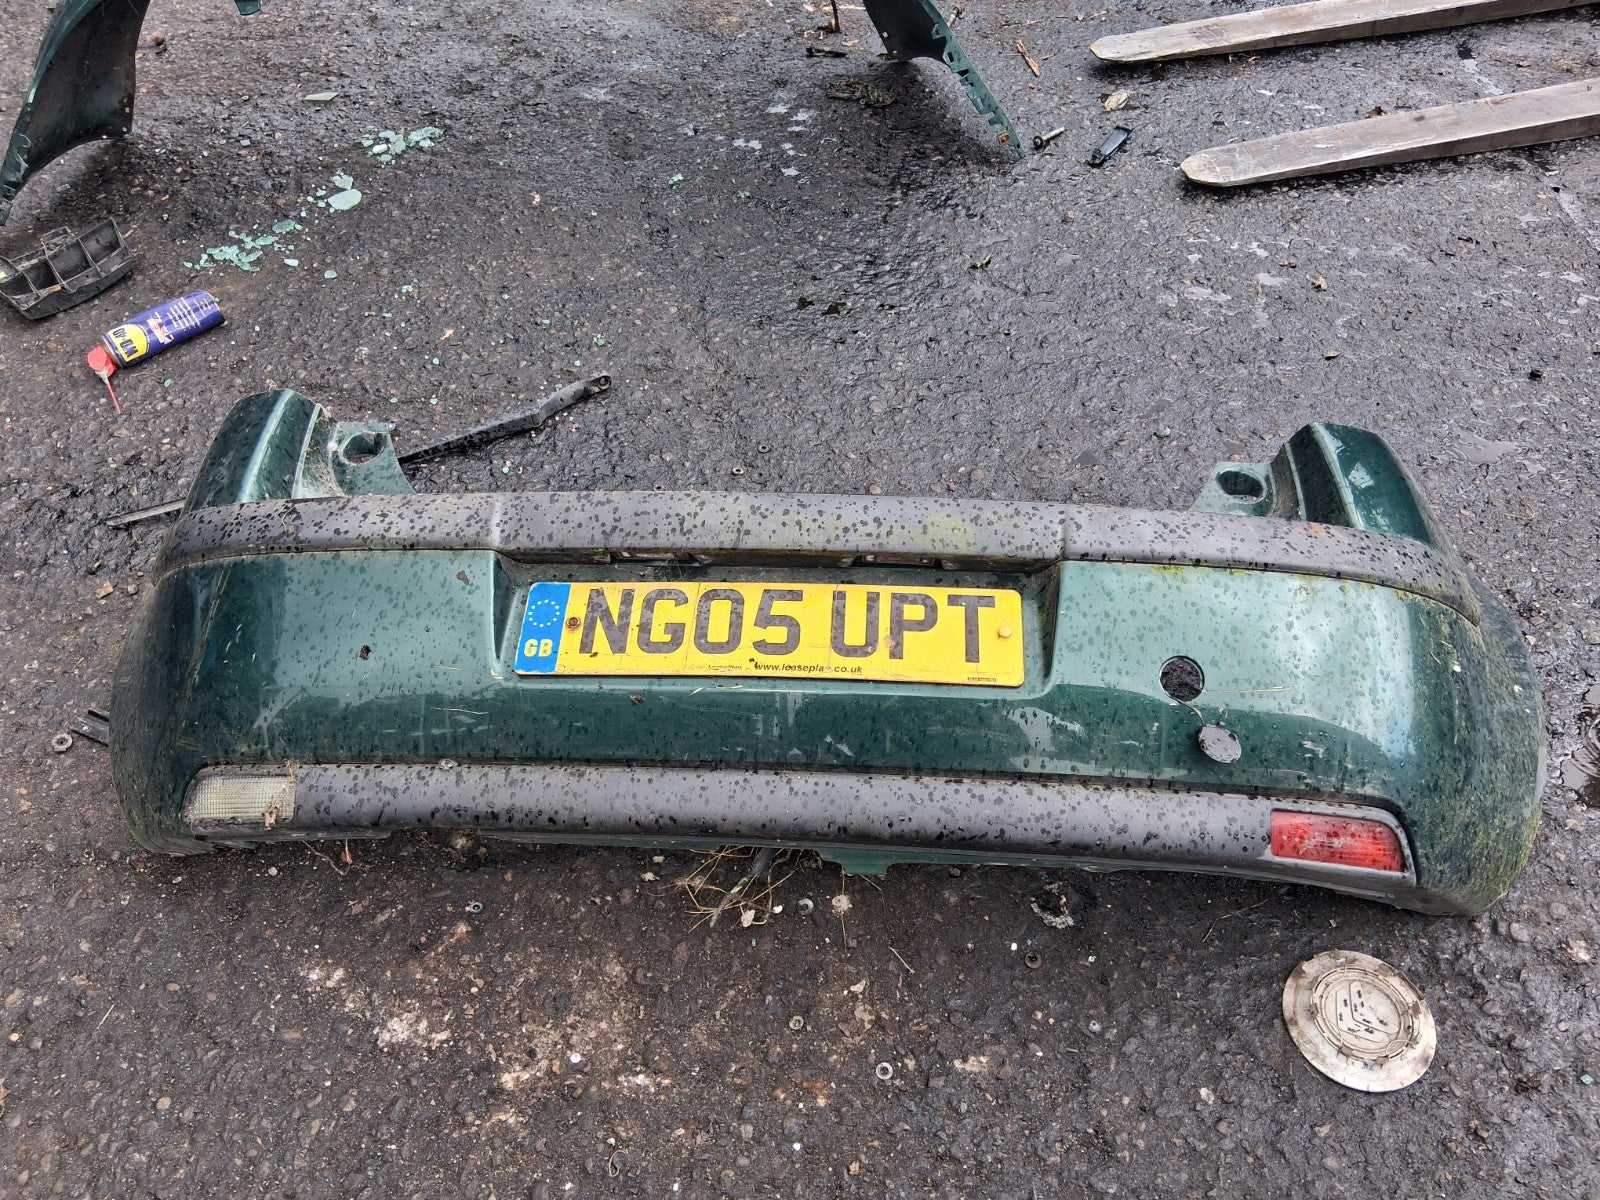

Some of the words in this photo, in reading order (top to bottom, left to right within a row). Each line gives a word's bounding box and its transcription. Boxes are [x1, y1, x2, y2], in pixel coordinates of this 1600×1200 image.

[112, 327, 139, 358] WD-40
[578, 588, 802, 656] NG05
[830, 590, 996, 663] UPT
[523, 638, 553, 658] GB
[757, 662, 863, 674] www.leasepla.co.uk
